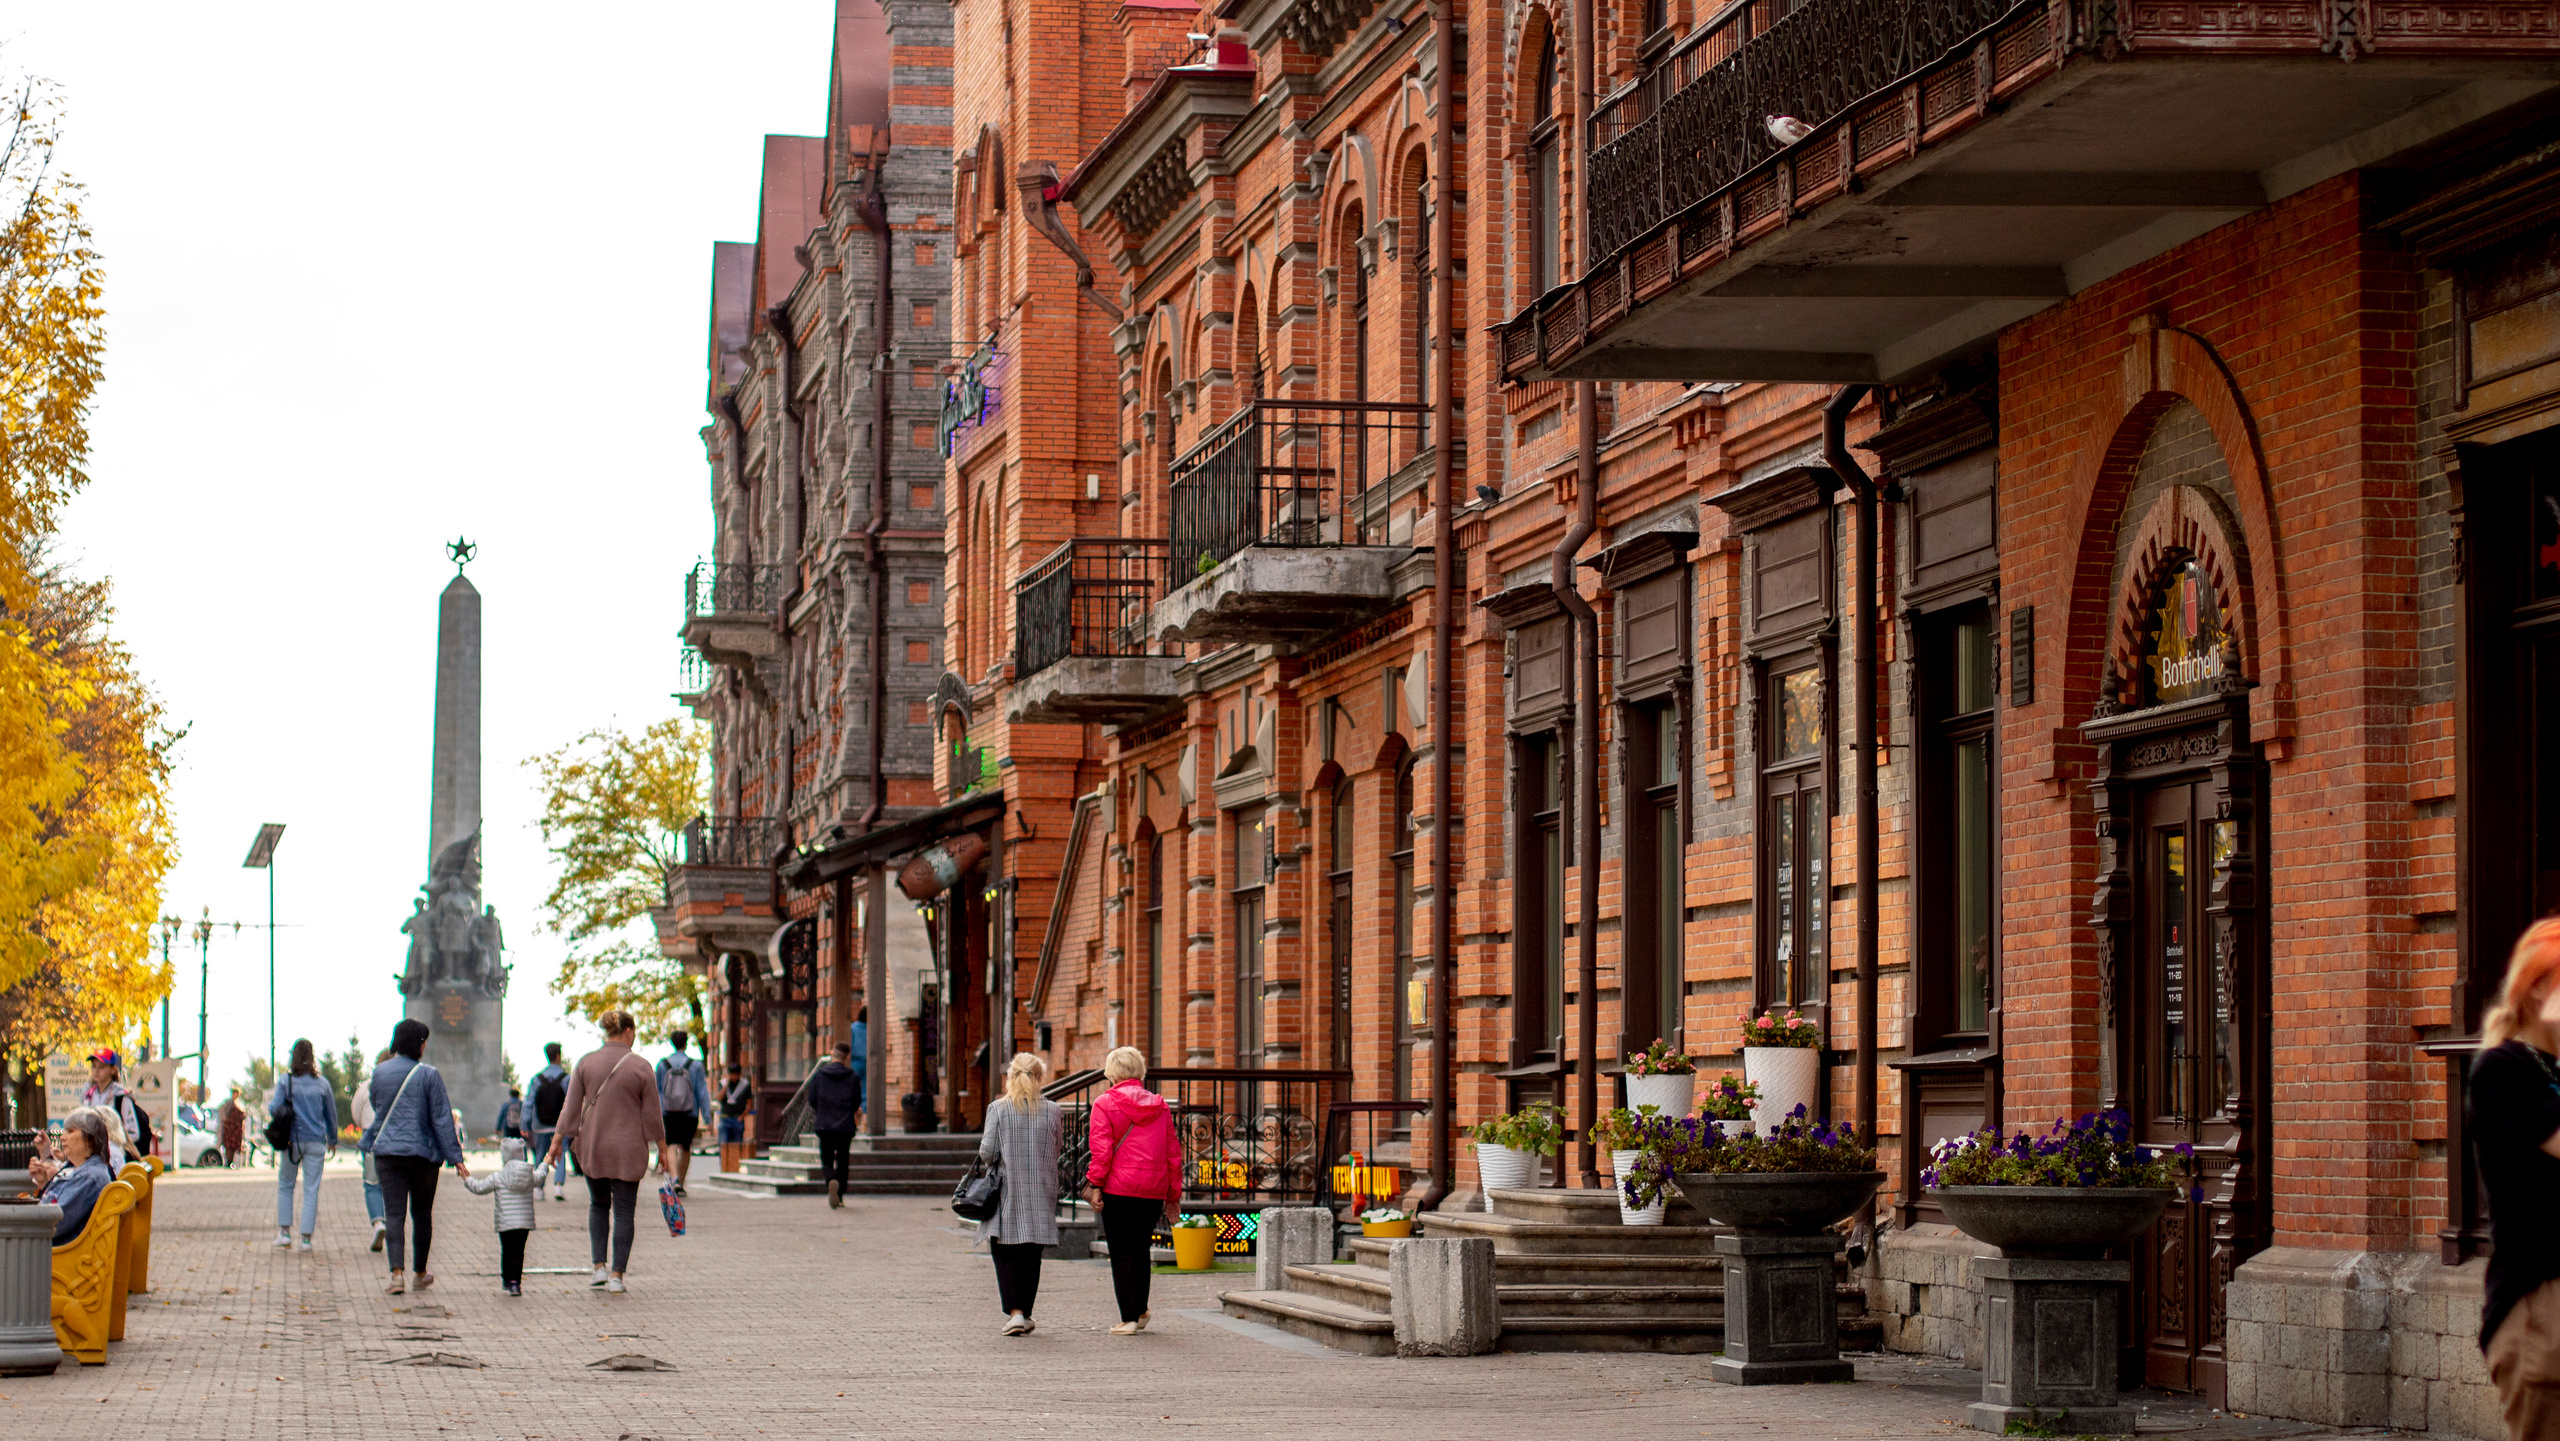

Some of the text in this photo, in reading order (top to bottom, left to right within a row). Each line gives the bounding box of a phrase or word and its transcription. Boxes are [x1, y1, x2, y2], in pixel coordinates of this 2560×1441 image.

[2162, 643, 2220, 689] Bottichelli
[2168, 971, 2182, 980] 11-20
[1214, 1240, 1249, 1253] СКИЙ
